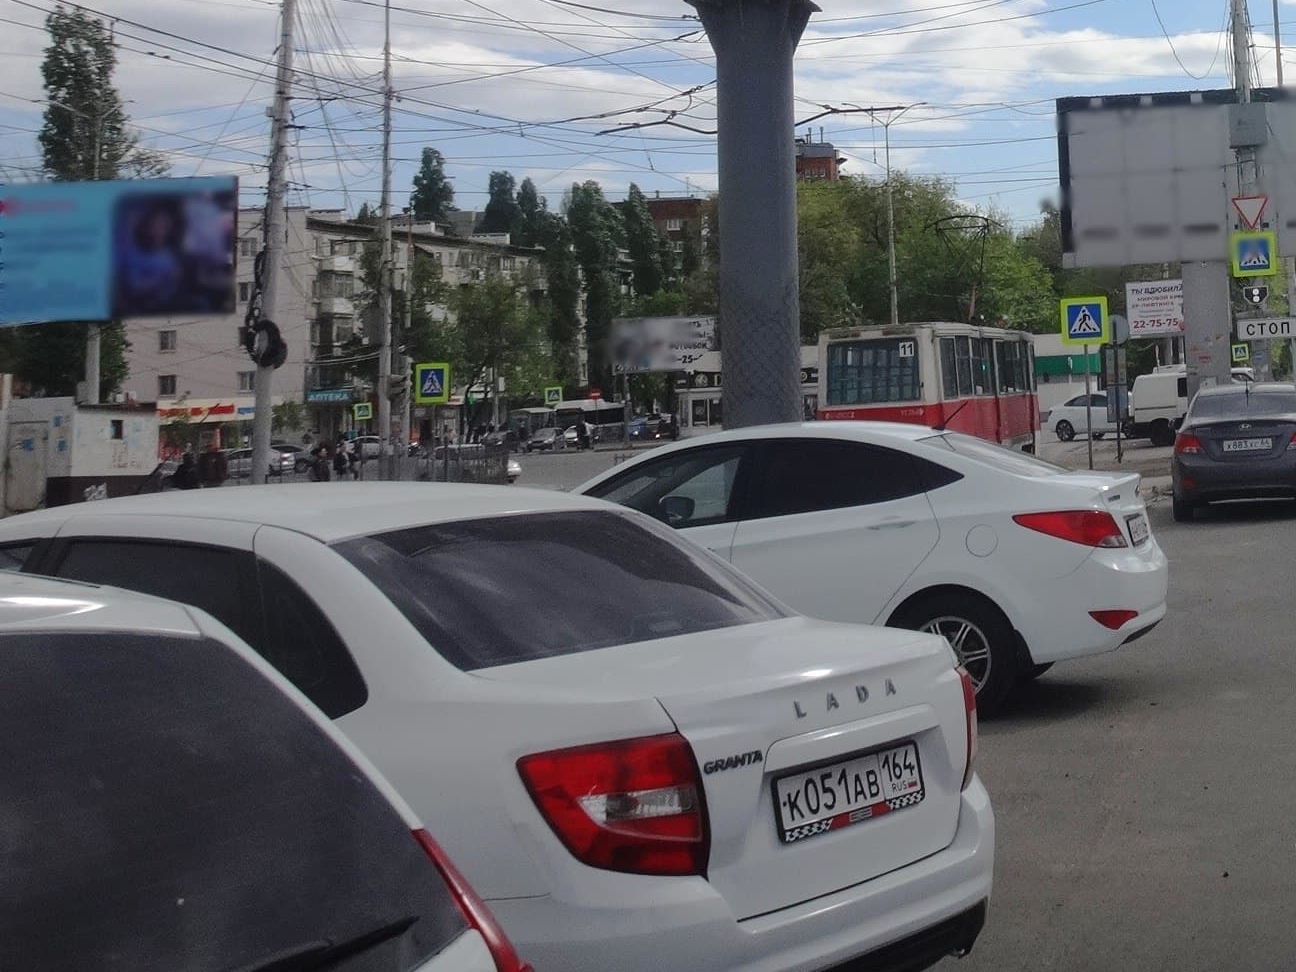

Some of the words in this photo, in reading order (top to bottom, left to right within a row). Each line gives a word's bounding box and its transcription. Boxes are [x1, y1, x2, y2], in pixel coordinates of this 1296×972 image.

[1133, 317, 1179, 329] 22-75-75
[1246, 321, 1291, 336] СТОП
[900, 343, 913, 356] 11
[793, 679, 897, 718] LADA
[703, 750, 763, 775] GRANTA
[787, 768, 880, 821] К051АВ
[882, 750, 915, 782] 164
[891, 780, 907, 792] RUS
